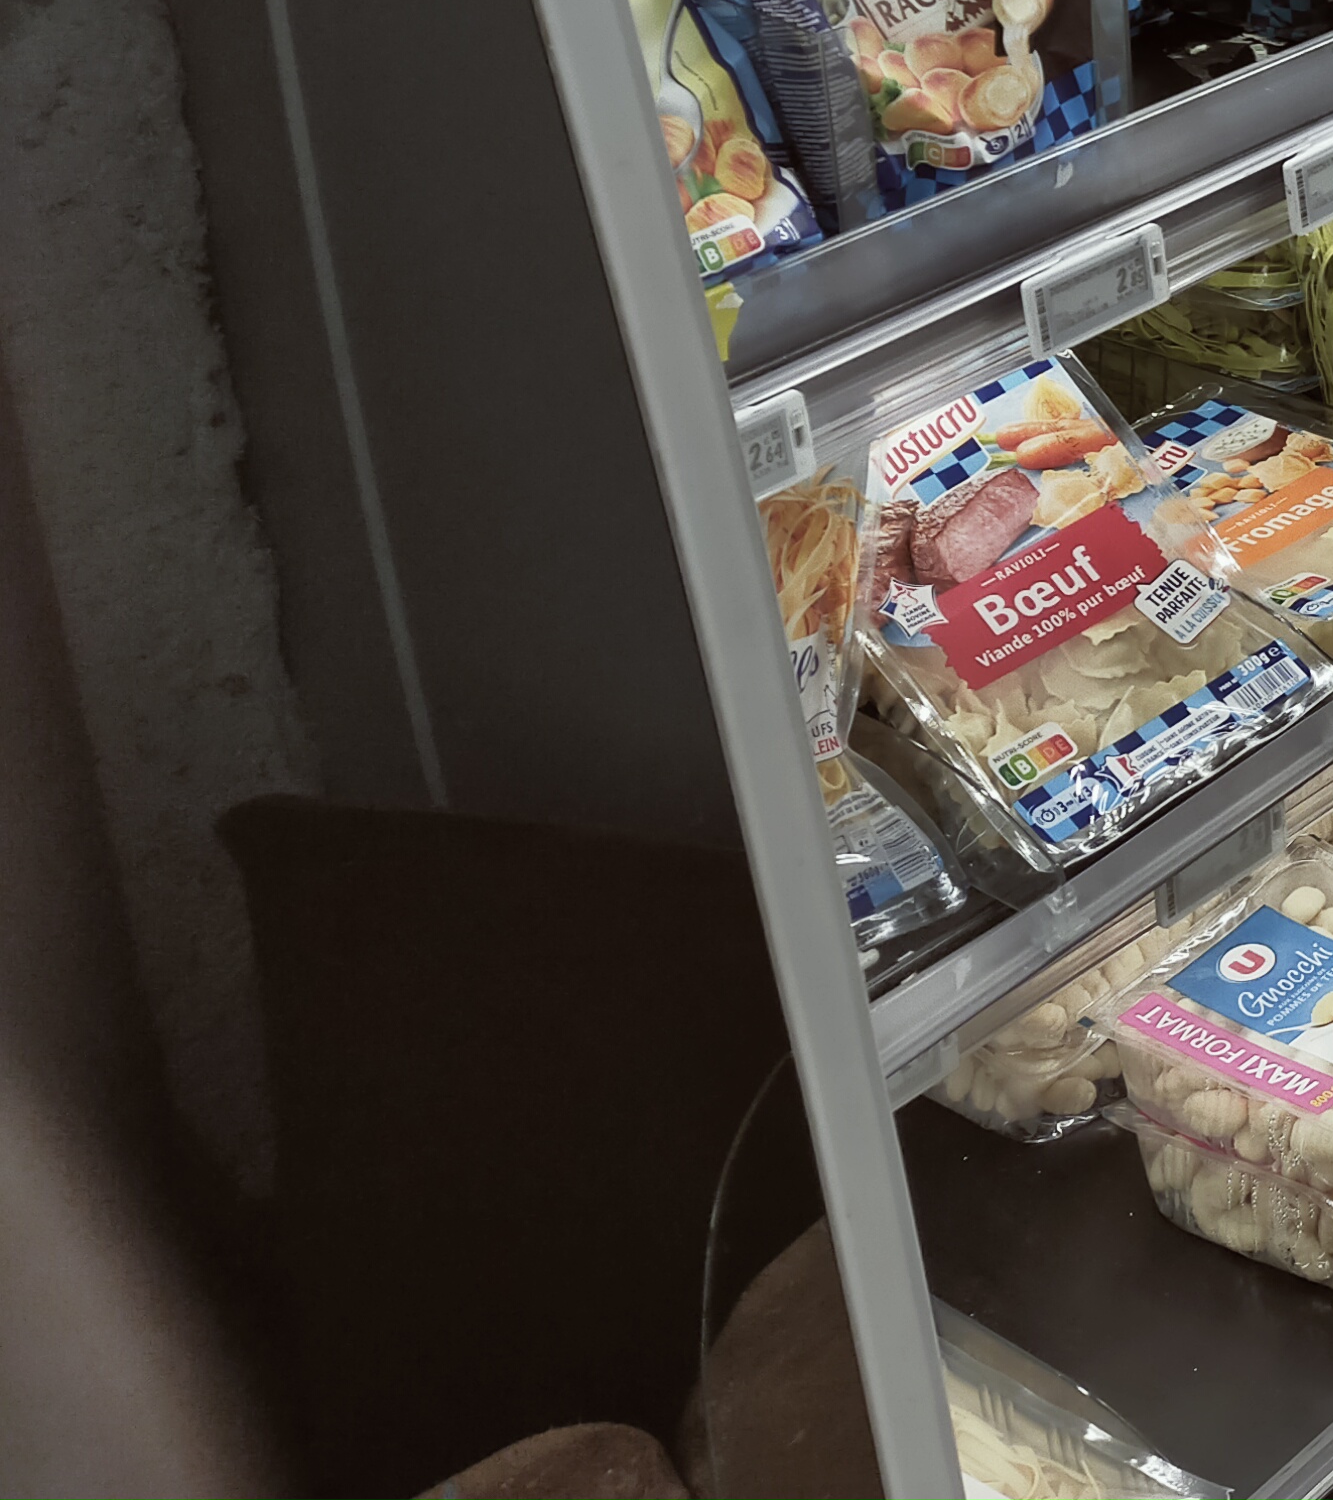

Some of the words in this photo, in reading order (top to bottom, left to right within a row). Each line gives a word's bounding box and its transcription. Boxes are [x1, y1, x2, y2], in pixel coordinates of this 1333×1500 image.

[882, 395, 979, 488] Lustucru
[995, 546, 1047, 582] RAVIOLI
[1148, 566, 1191, 606] TENUE
[972, 544, 1102, 637] Bœuf
[1157, 577, 1208, 625] PARFAITE
[975, 630, 1033, 668] Viande
[1031, 605, 1077, 640] 100%
[1078, 591, 1103, 617] pur
[1103, 565, 1147, 597] bœuf
[992, 730, 1045, 765] NUTRI-SCORE
[1266, 991, 1312, 1027] POMMES
[1135, 1004, 1241, 1064] FORMAT
[1236, 1055, 1321, 1097] MAXI
